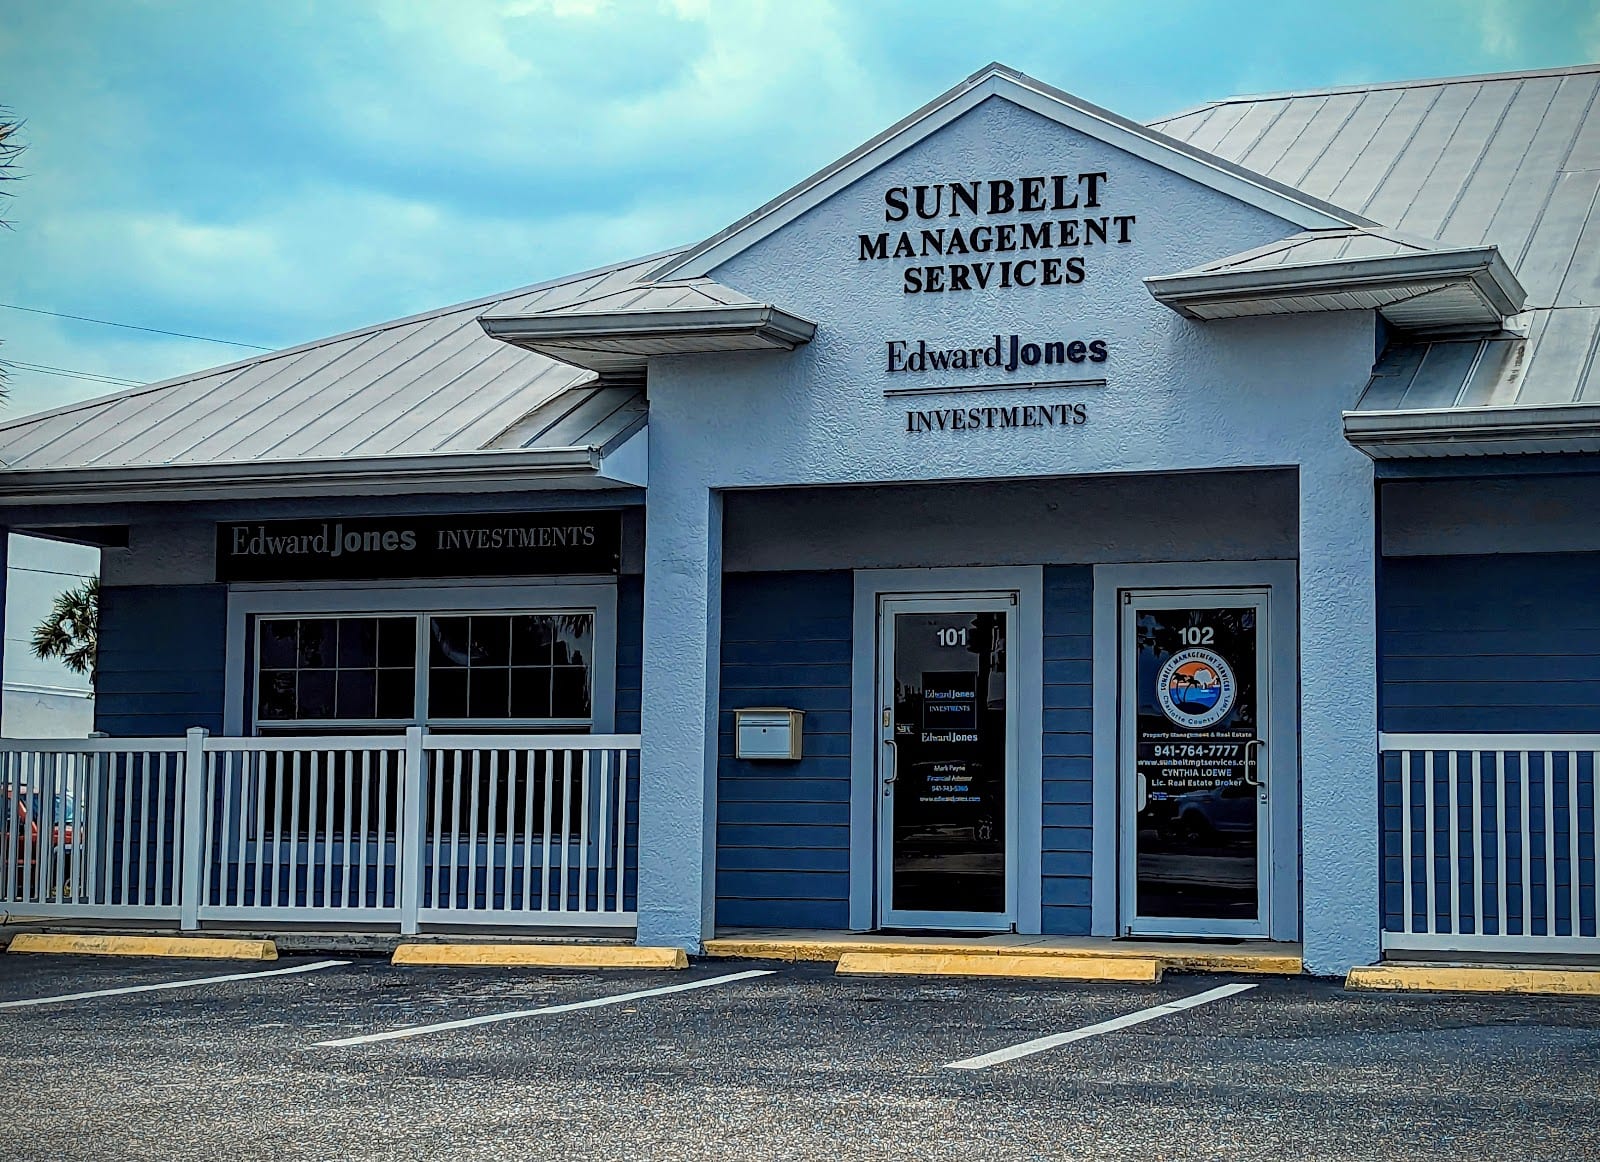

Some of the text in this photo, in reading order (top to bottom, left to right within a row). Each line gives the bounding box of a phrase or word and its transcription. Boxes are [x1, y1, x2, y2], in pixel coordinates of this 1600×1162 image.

[885, 172, 1107, 223] SUNBELT
[858, 216, 1136, 261] MANAGEMENT
[904, 257, 1086, 294] SERVICES
[906, 404, 1088, 433] INVESTMENTS
[437, 526, 596, 550] INVESTMENTS
[936, 627, 966, 647] 101
[1178, 626, 1215, 645] 102
[1173, 651, 1219, 665] MANAGEMENT
[1216, 663, 1230, 692] SERVICES
[1154, 745, 1239, 757] 941-764-7777
[1161, 768, 1232, 777] CYNTHIA LOEWE
[1168, 779, 1186, 787] Real
[1187, 779, 1213, 787] Estate
[1215, 779, 1243, 787] Broker
